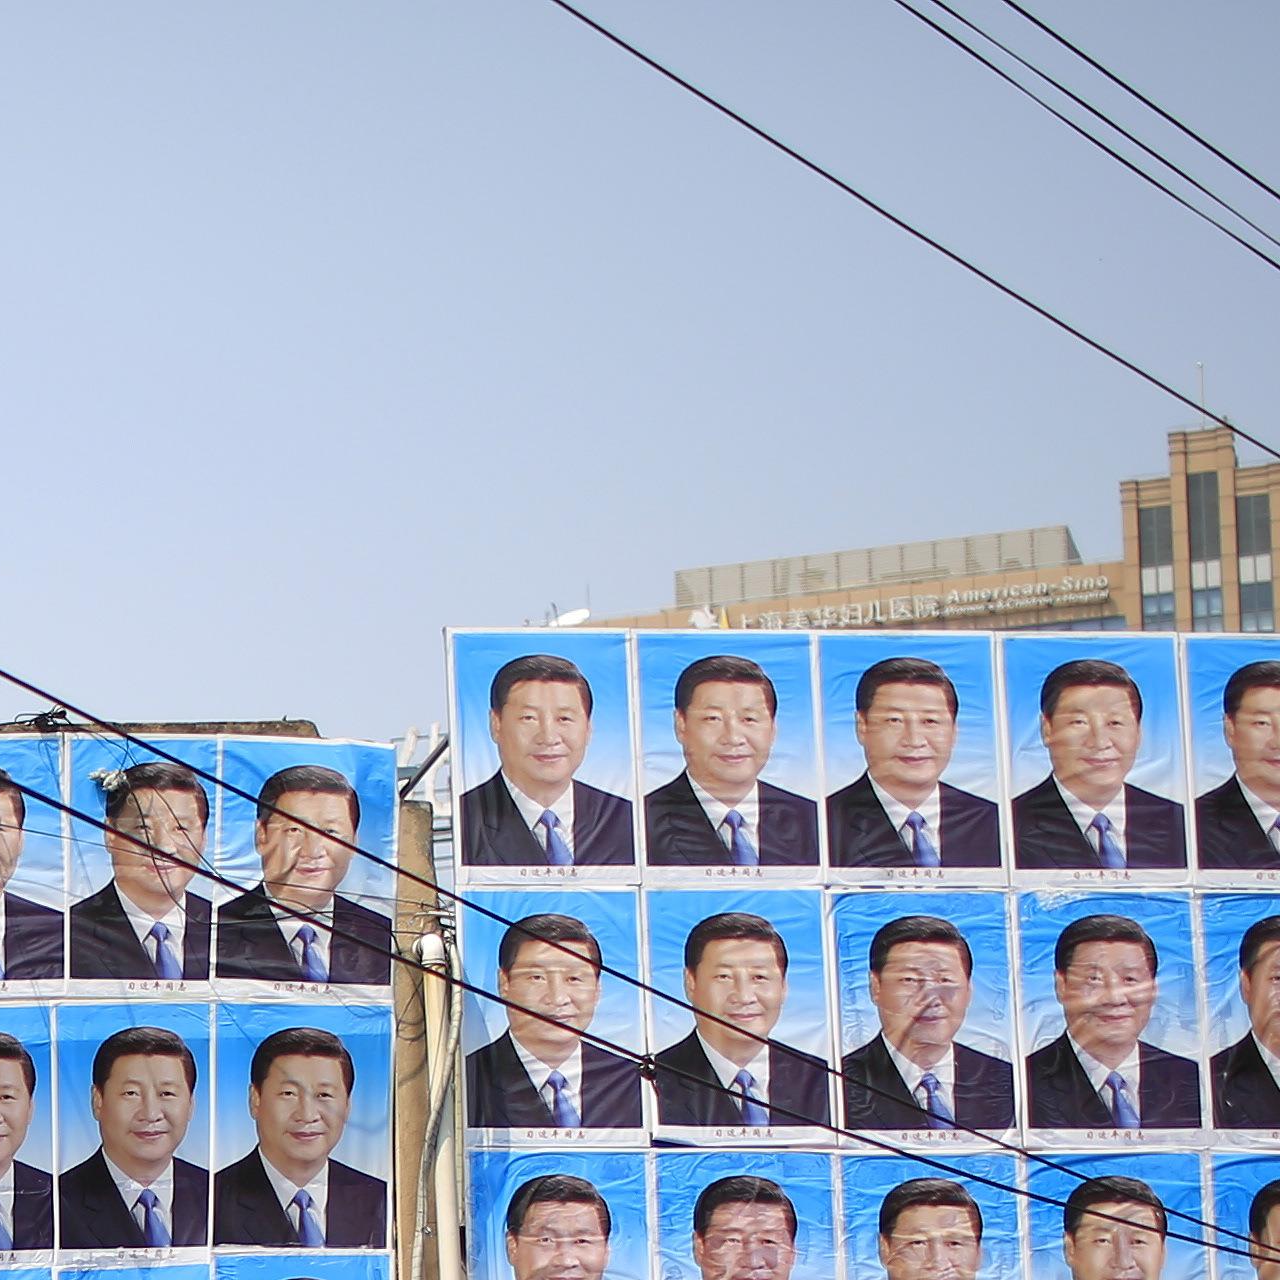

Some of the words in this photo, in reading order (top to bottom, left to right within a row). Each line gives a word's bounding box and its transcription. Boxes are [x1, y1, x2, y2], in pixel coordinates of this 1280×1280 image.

[946, 576, 1109, 605] American-Sino
[519, 867, 580, 878] 习近平同志
[704, 867, 765, 877] 习近平同志
[886, 868, 947, 879] 习近平同志
[127, 981, 188, 992] 习近平同志
[273, 982, 334, 995] 习近平同志
[526, 1129, 587, 1139] 习近平同志
[714, 1127, 775, 1138] 习近平同志
[900, 1131, 961, 1142] 习近平同志
[1085, 1130, 1146, 1140] 习近平同志
